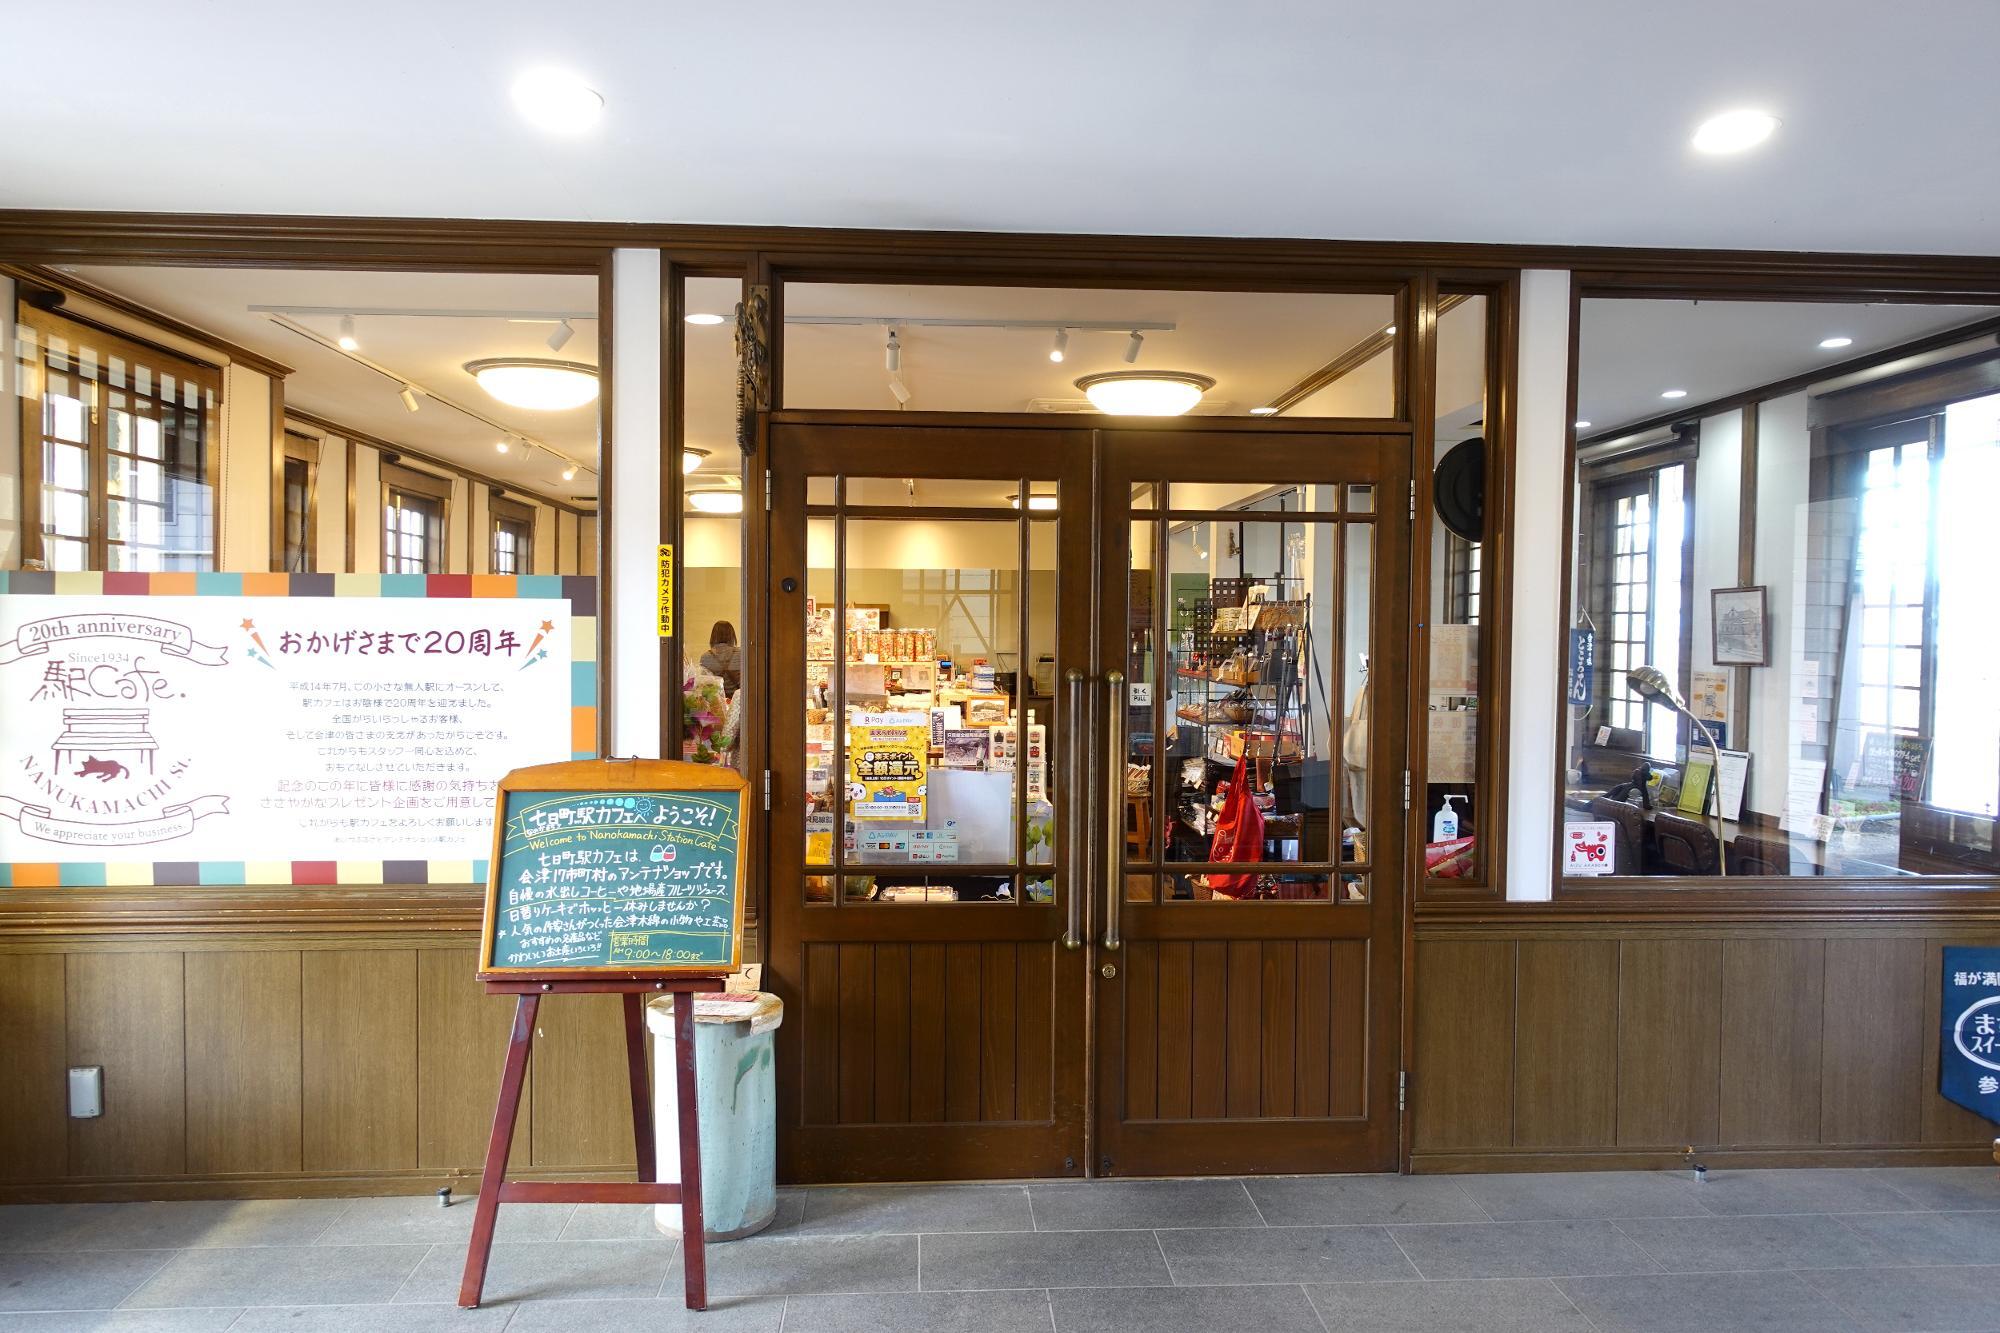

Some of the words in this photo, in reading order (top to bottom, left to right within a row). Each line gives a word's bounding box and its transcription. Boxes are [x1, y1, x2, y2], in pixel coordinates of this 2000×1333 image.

[660, 559, 670, 633] 防犯カメラ作動中
[29, 619, 70, 642] 20th
[77, 616, 183, 643] anniversary
[279, 628, 522, 657] おかげさまで20周年
[857, 760, 919, 776] 全額還元
[20, 754, 171, 815] NANUKAMACHI
[34, 821, 51, 835] We
[53, 827, 108, 842] appreciate
[111, 826, 137, 842] your
[529, 837, 573, 851] Welcome
[576, 833, 587, 842] to
[589, 829, 658, 841] Nanokamachi
[659, 829, 694, 845] Station
[694, 835, 717, 851] Cafe
[1953, 971, 2000, 987] 福が満
